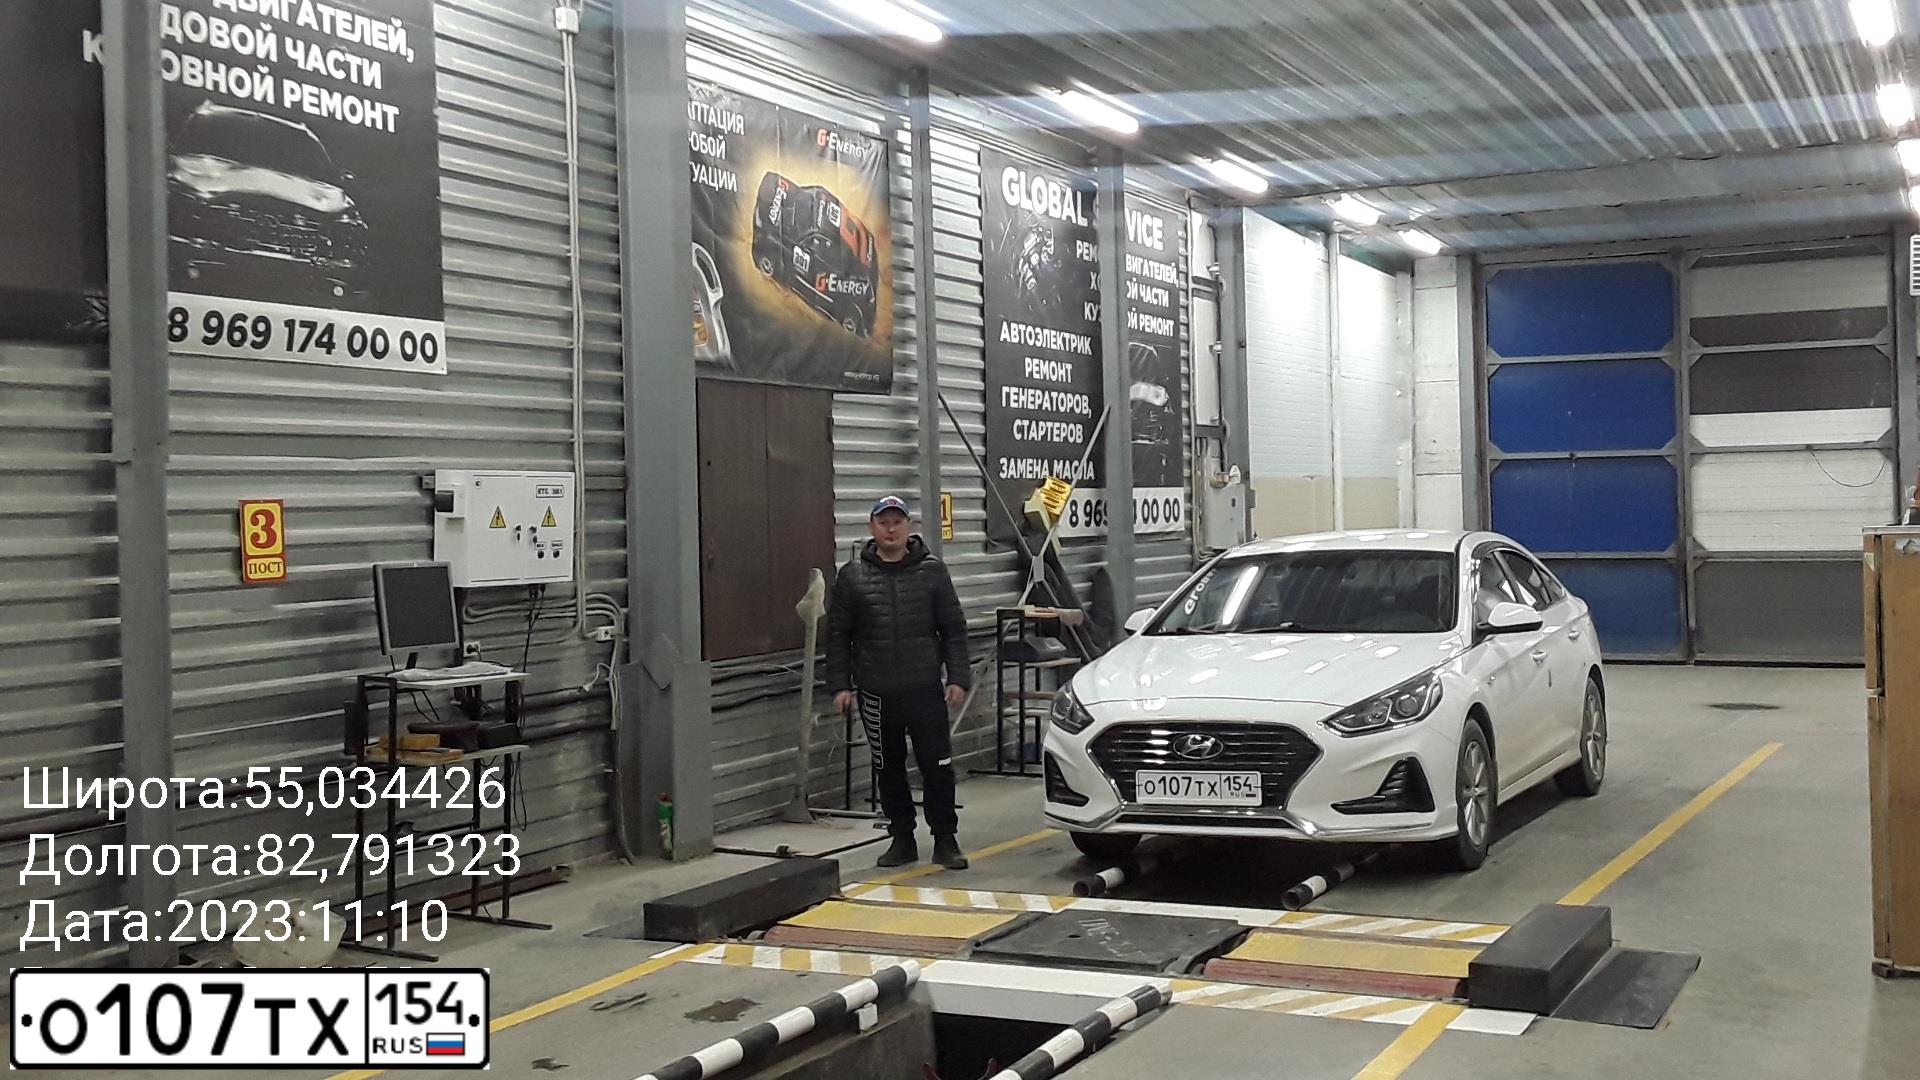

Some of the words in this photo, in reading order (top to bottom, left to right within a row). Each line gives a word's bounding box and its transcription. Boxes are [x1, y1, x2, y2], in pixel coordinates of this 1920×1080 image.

[160, 2, 278, 62] ДОВОЙ
[284, 36, 382, 89] ЧАСТИ
[283, 78, 400, 133] РЕМОНТ
[688, 131, 726, 160] ЮБОЙ
[689, 160, 738, 192] УАЦИИ
[1001, 166, 1088, 226] GLOBAL
[1124, 207, 1164, 251] VICE
[1076, 239, 1098, 262] РЕМ
[1125, 253, 1178, 288] ВИГАТЕЛЕЙ,
[1139, 283, 1169, 308] ЧАСТИ
[168, 306, 189, 342] 8
[201, 310, 273, 350] 969
[284, 318, 337, 355] 174
[347, 325, 390, 360] 00
[400, 330, 438, 364] 00
[999, 321, 1092, 355] АВТОЭЛЕКТРИК
[1139, 313, 1174, 337] РЕМОНТ
[1024, 357, 1072, 383] РЕМОНТ
[1001, 386, 1092, 418] ГЕНЕРАТОРОВ,
[1012, 419, 1083, 443] СТАРТЕРОВ
[999, 457, 1049, 480] ЗАМЕНА
[1053, 459, 1096, 481] МАСЛА
[1069, 499, 1079, 528] 8
[1141, 498, 1160, 525] 00
[1163, 498, 1180, 524] 00
[250, 508, 277, 550] 3
[248, 561, 282, 575] ПОСТ
[1144, 776, 1218, 797] О107ТХ
[1223, 775, 1252, 792] 154
